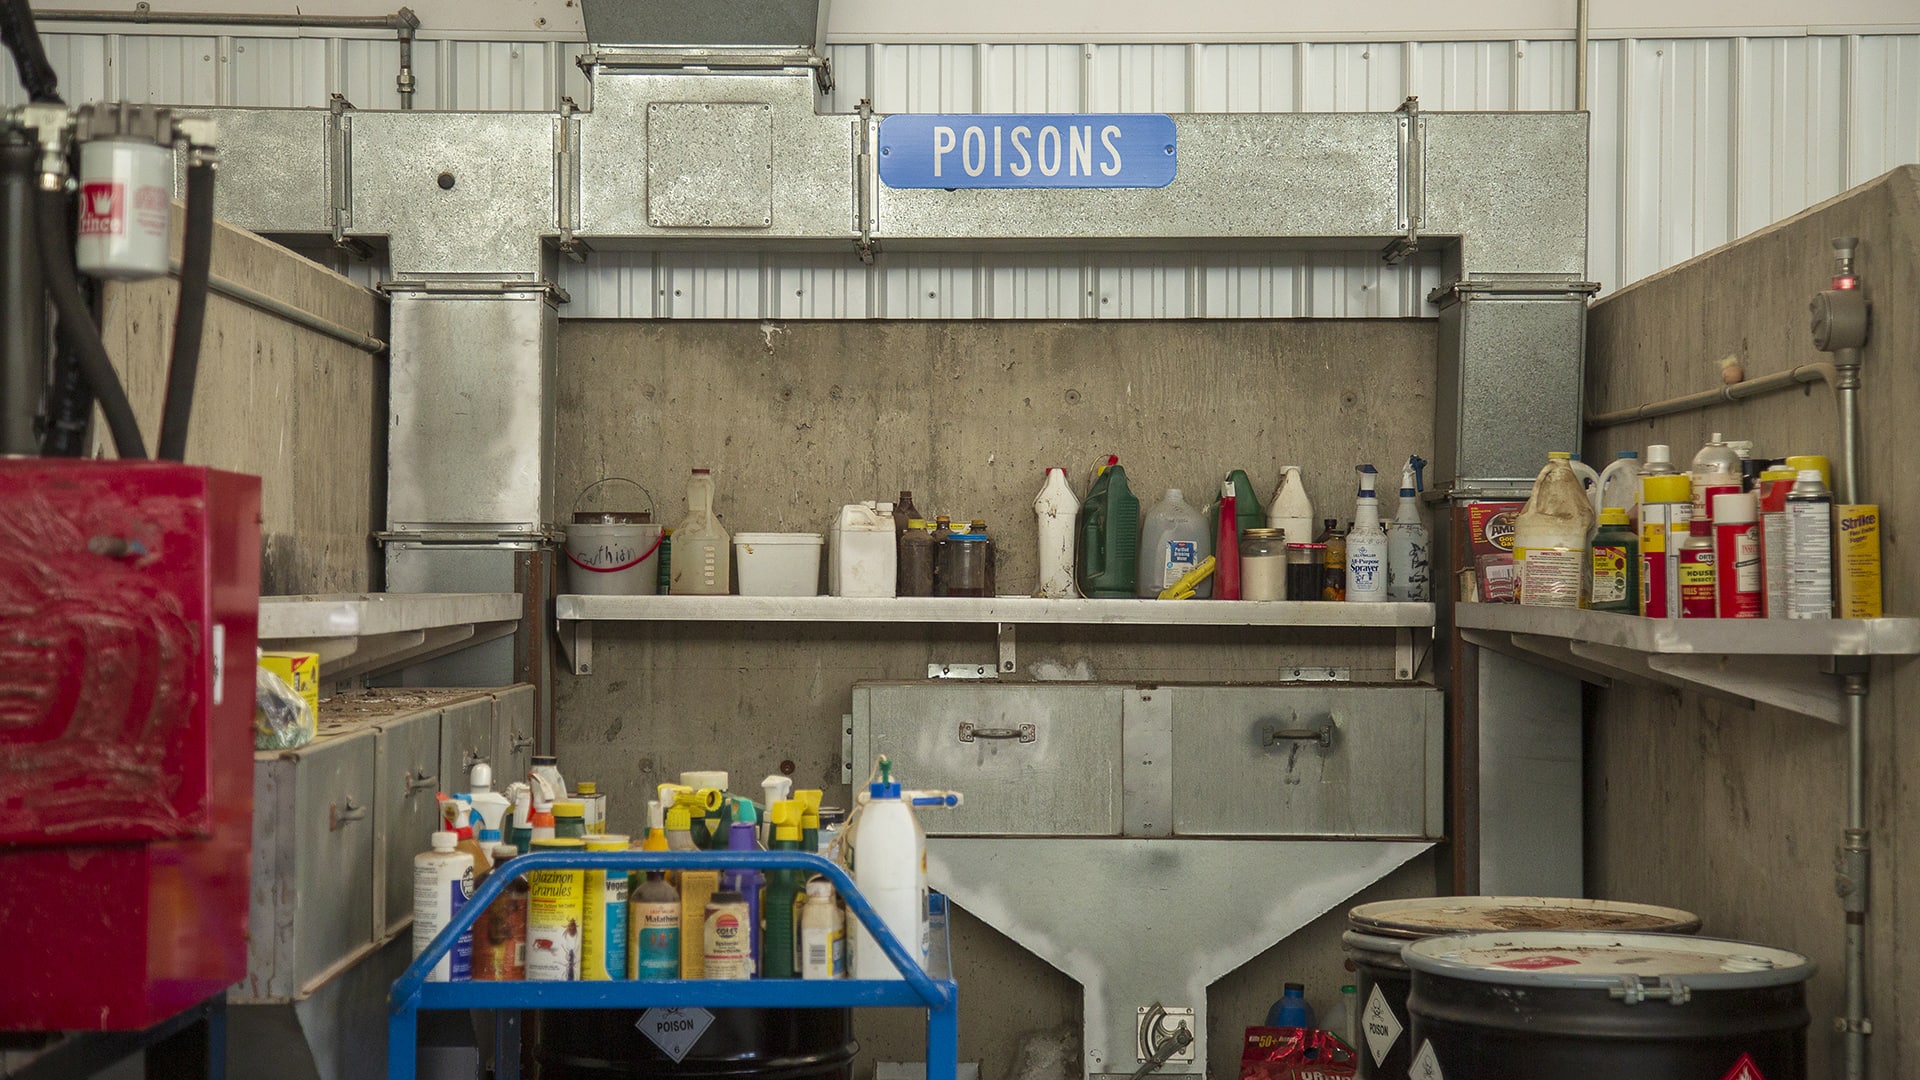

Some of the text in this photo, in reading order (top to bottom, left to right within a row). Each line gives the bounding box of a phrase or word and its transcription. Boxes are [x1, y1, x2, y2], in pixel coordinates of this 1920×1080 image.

[934, 125, 1122, 177] POISONS
[1841, 514, 1876, 531] Strike
[1491, 525, 1515, 537] AMD
[1350, 563, 1379, 573] Sprayer
[532, 870, 573, 884] Diazinon
[532, 883, 572, 896] Granules
[656, 1019, 694, 1033] POISON
[1369, 1023, 1389, 1037] POISON
[1259, 1035, 1277, 1048] 50+
[674, 1046, 680, 1054] 6
